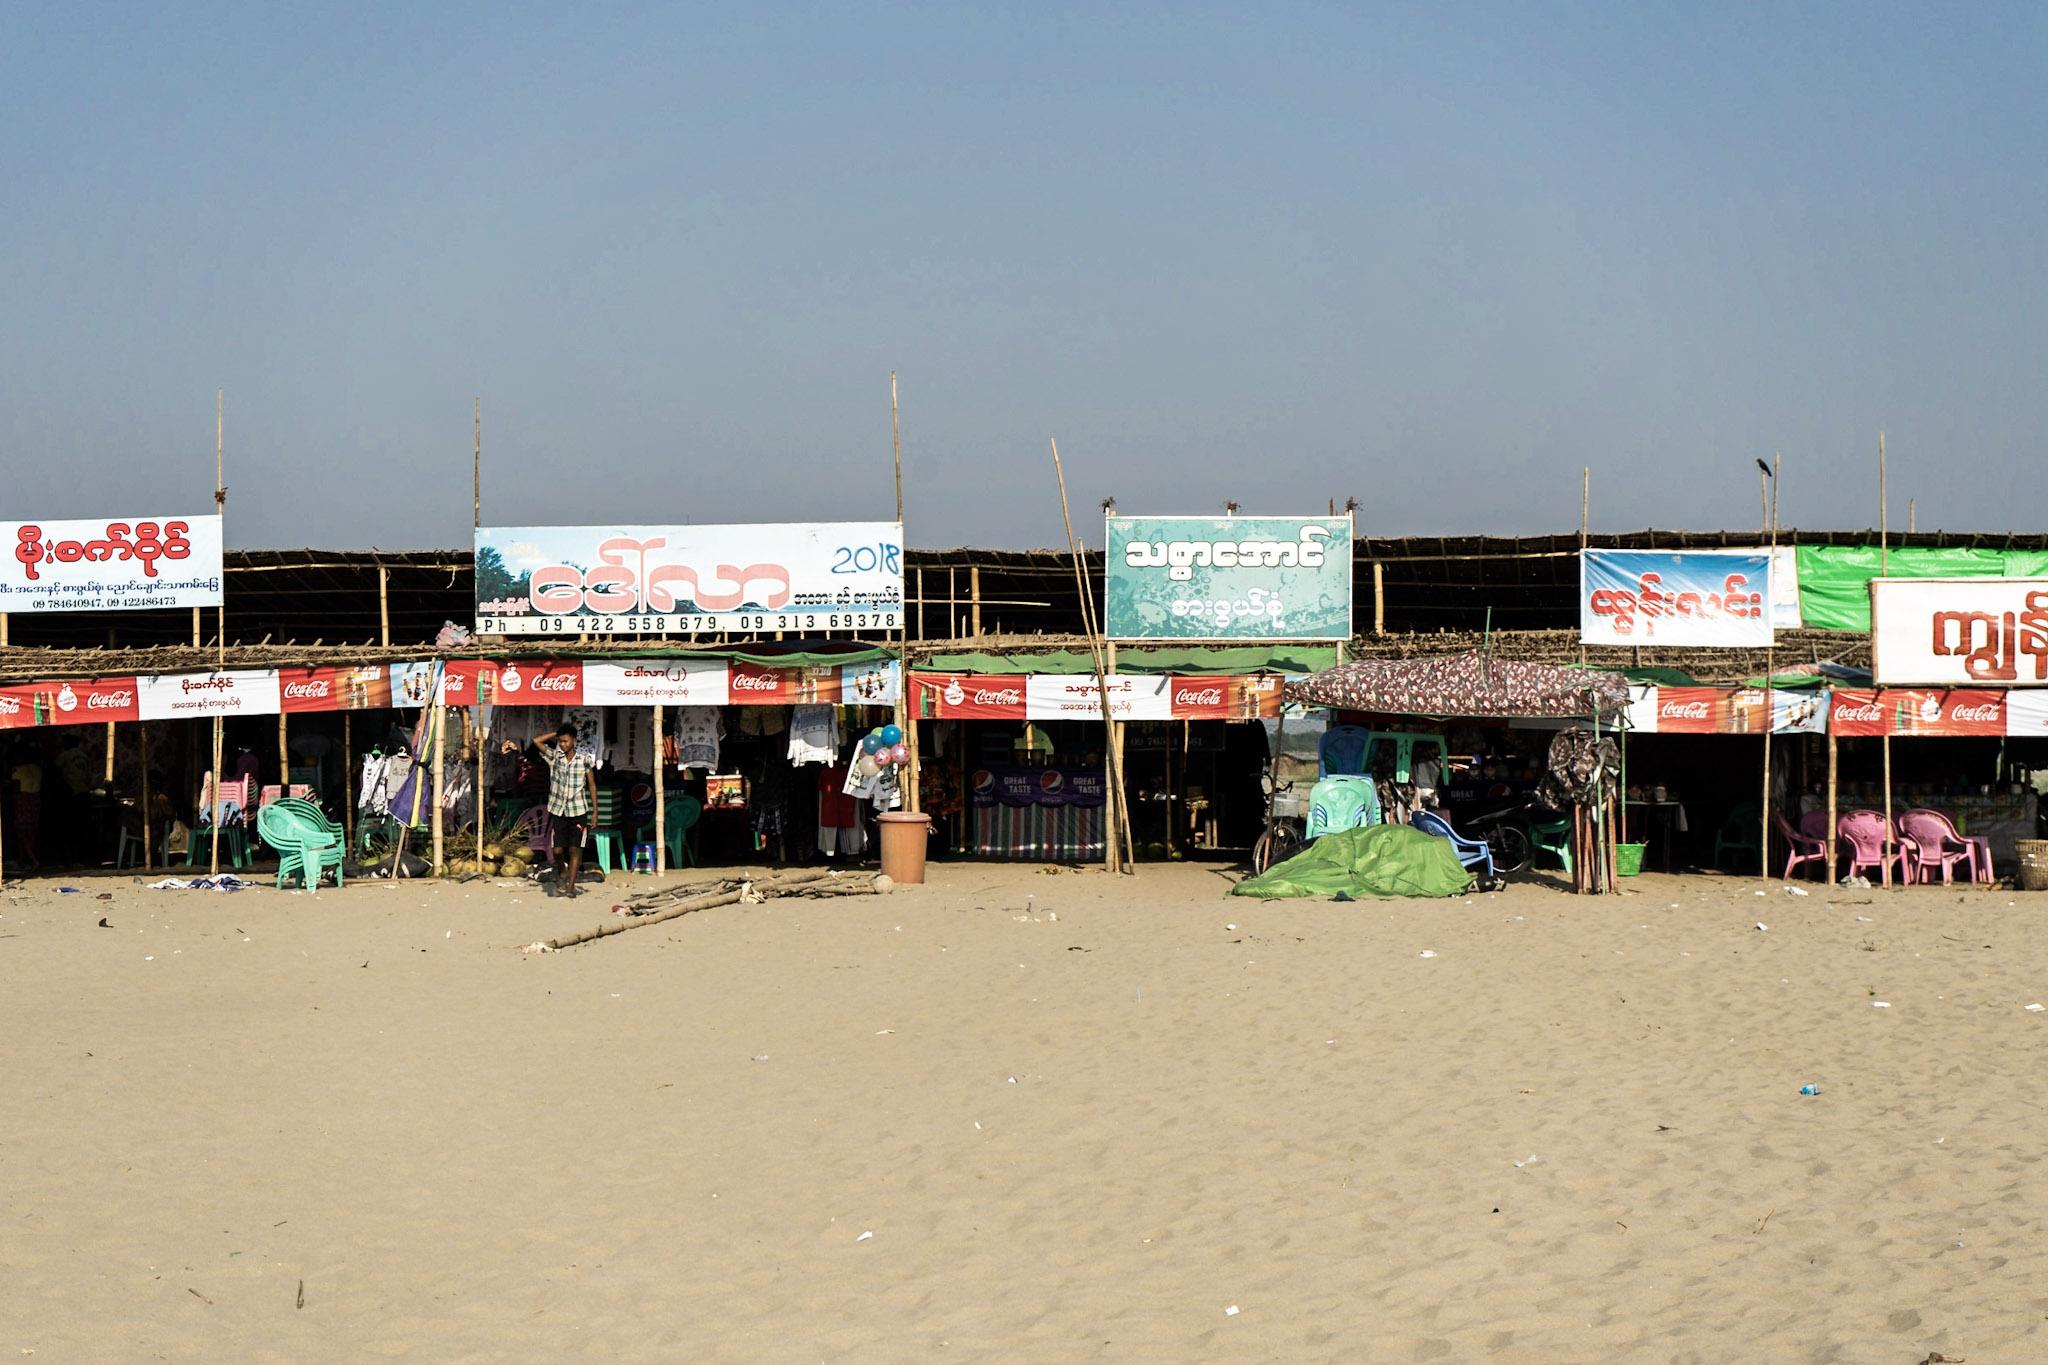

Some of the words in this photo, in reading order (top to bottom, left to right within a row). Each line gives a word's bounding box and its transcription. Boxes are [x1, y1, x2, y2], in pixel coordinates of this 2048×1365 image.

[831, 542, 900, 576] 2018
[32, 600, 45, 609] 09
[107, 598, 120, 607] 09
[484, 618, 507, 632] Ph
[540, 618, 563, 632] 09
[577, 617, 614, 631] 422
[628, 616, 665, 631] 558
[741, 616, 764, 630] 09
[778, 614, 815, 629] 313
[829, 613, 895, 629] 69378
[1004, 776, 1026, 785] GREAT
[1073, 777, 1096, 786] GREAT
[1009, 785, 1032, 794] TASTE
